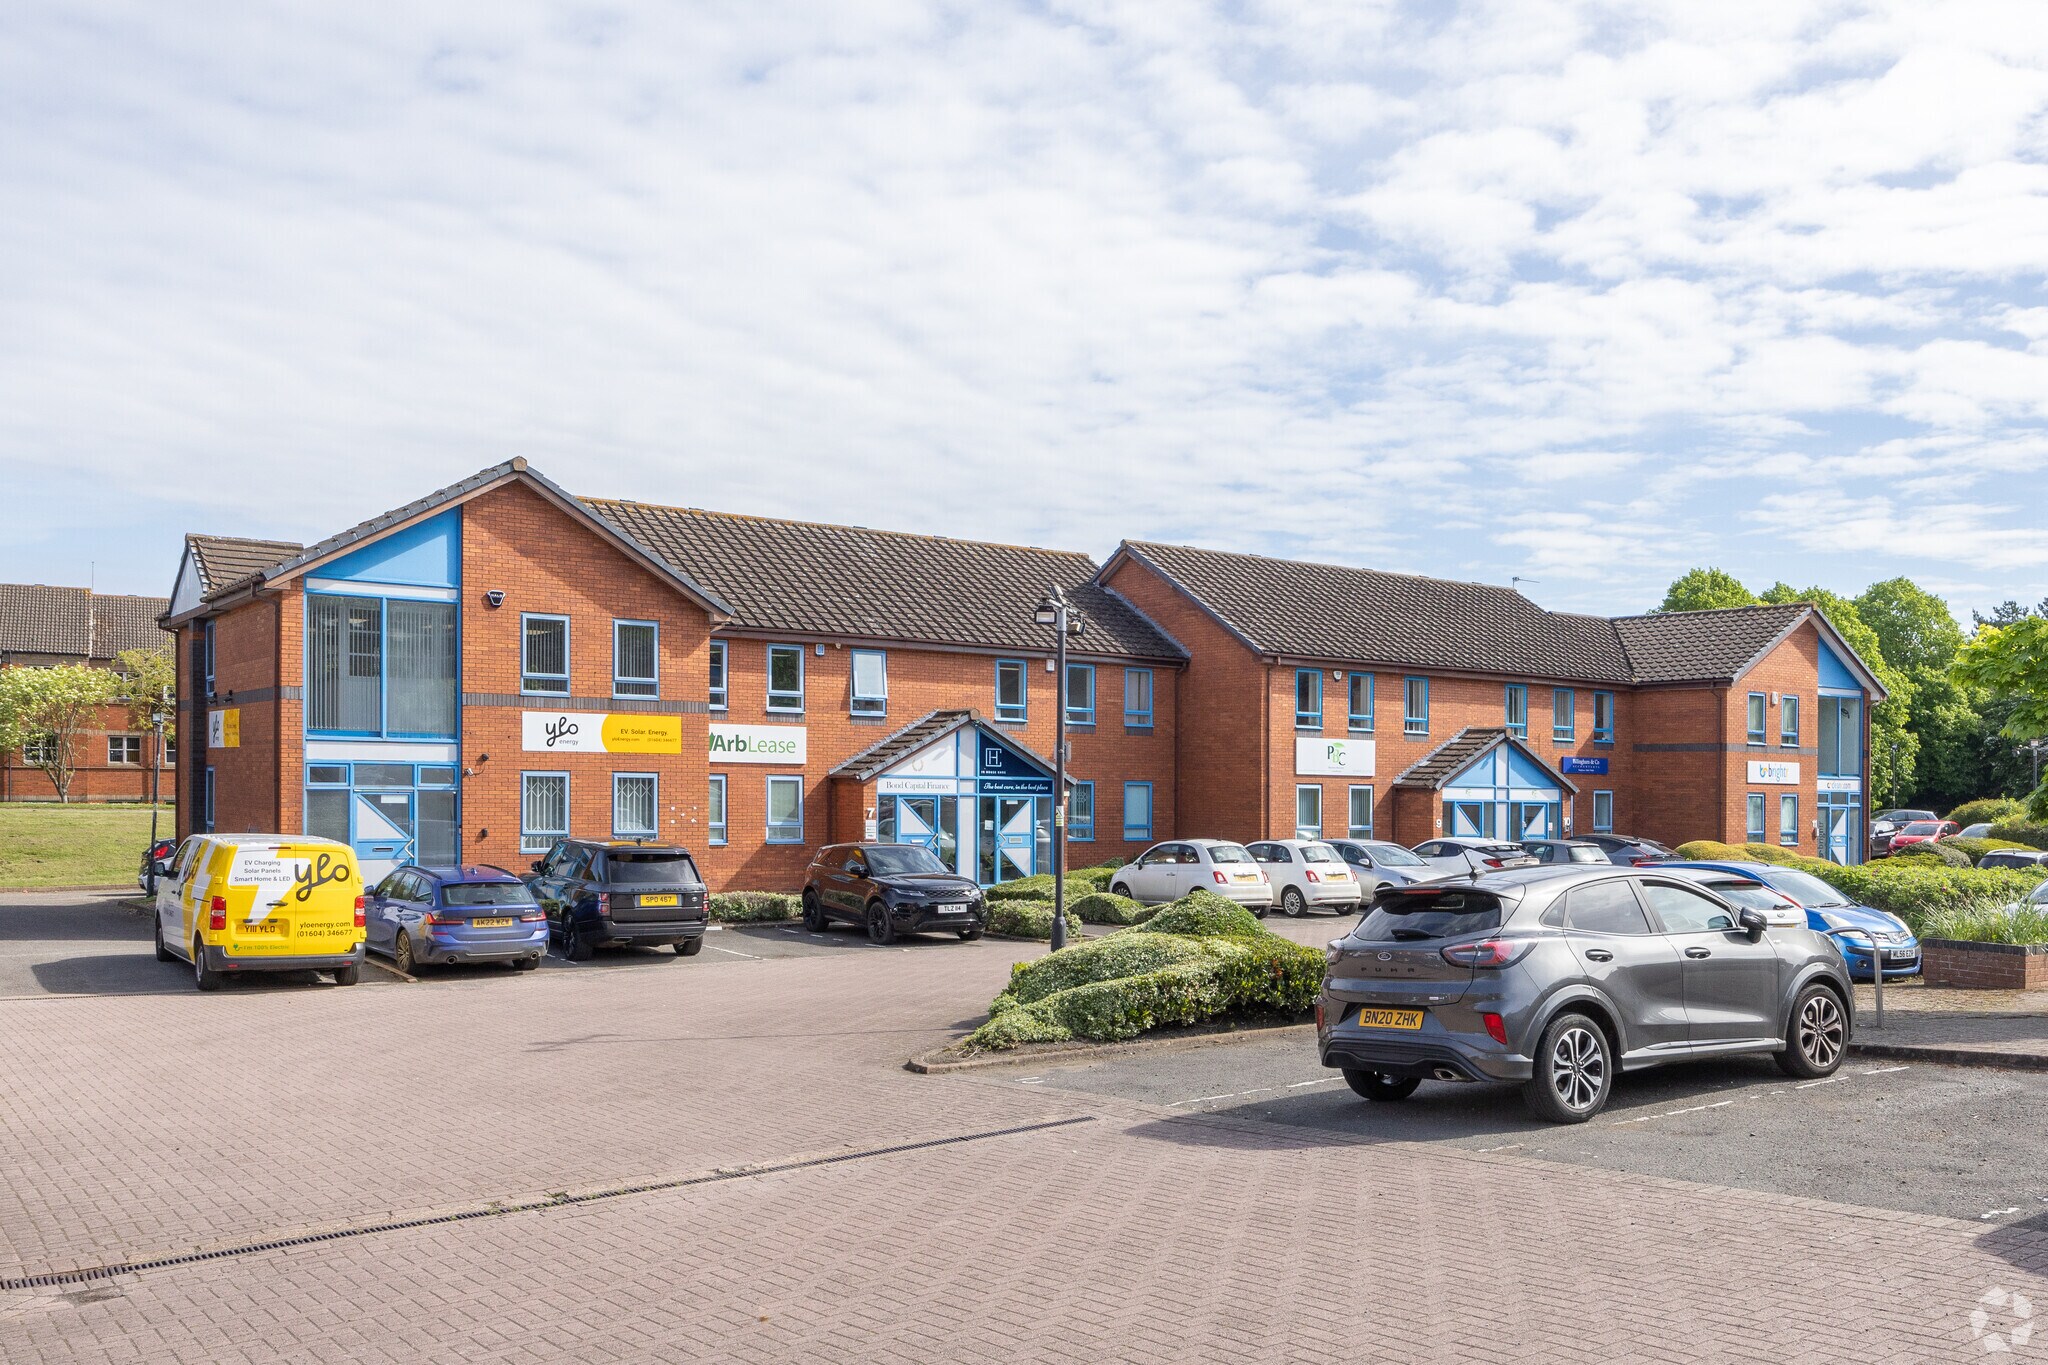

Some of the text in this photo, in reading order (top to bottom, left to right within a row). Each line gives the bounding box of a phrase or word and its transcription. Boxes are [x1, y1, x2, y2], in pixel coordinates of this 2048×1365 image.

[545, 716, 579, 747] ylo
[558, 738, 579, 746] energy
[712, 734, 796, 754] ArbLease
[886, 781, 949, 790] Bond Capital Finance
[983, 782, 993, 790] The
[994, 782, 1004, 790] best
[866, 807, 876, 818] 7
[1435, 818, 1442, 828] 9
[1563, 816, 1571, 826] 10
[253, 859, 281, 867] Charging
[294, 853, 350, 901] ylo
[259, 925, 276, 933] YLO
[299, 922, 351, 930] yloenergy.com
[296, 929, 353, 938] (01604) 346677
[1364, 1011, 1418, 1026] BN20 ZHK
